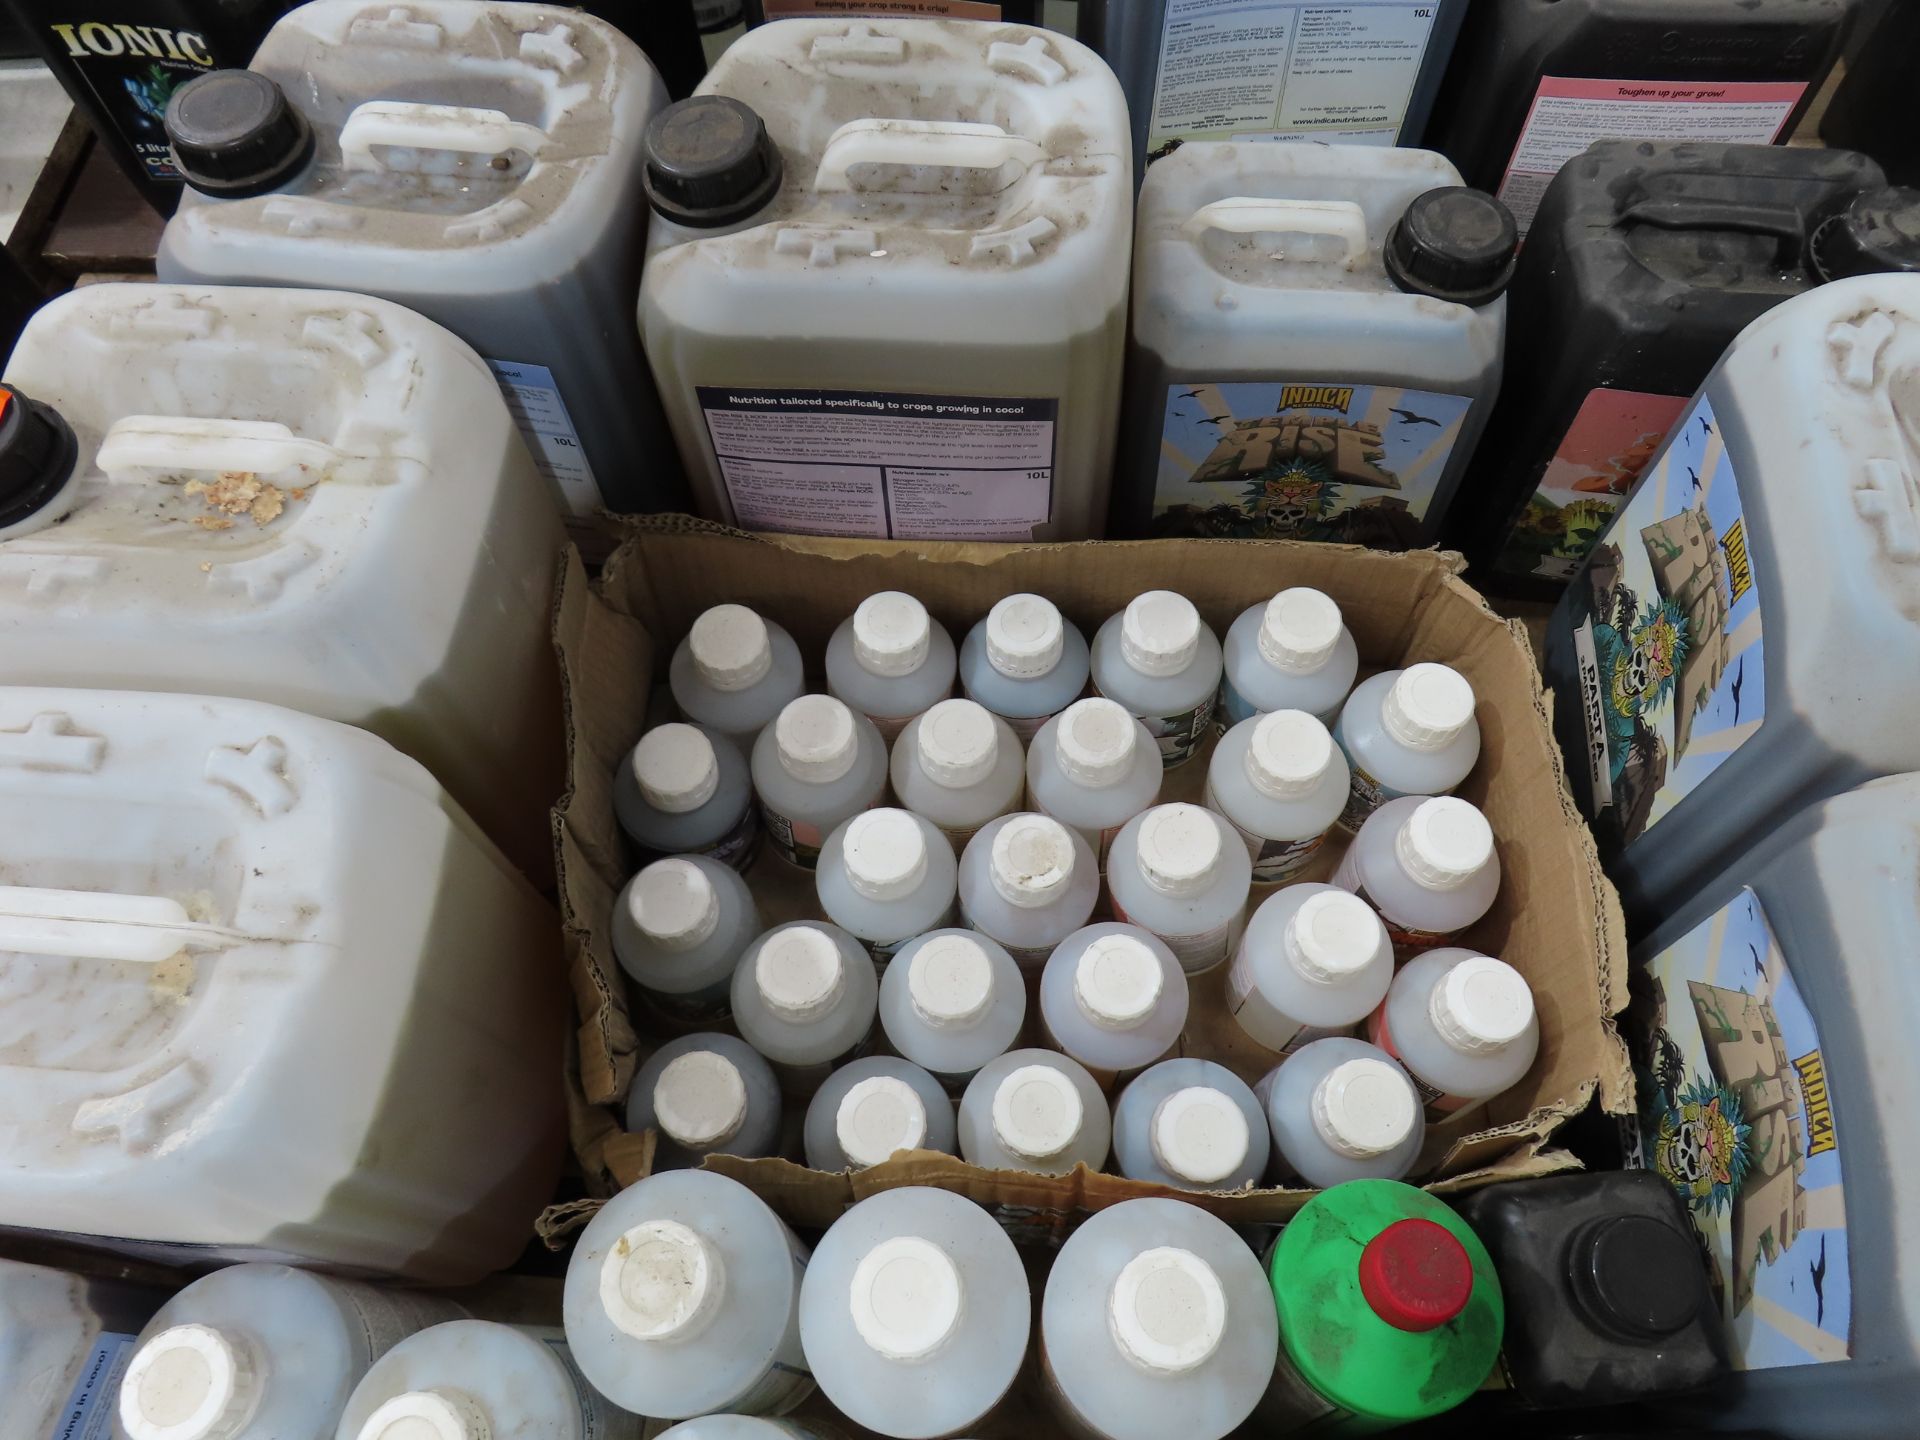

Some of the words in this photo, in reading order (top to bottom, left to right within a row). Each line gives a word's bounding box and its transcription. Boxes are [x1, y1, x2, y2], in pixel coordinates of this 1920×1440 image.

[815, 1, 846, 9] Keeping
[890, 2, 916, 10] strong
[1413, 9, 1431, 18] 10L
[51, 22, 213, 66] IONIC
[1618, 88, 1655, 97] Toughen
[1658, 90, 1669, 98] up
[1696, 90, 1725, 98] grow!
[1293, 116, 1387, 125] www.indicanutrients.com
[136, 144, 147, 152] 5
[729, 396, 777, 405] Nutrition
[781, 398, 821, 406] tailored
[825, 398, 885, 410] specifically
[903, 403, 933, 411] crops
[936, 405, 979, 414] growing
[982, 405, 992, 413] in
[995, 406, 1024, 414] coco!
[1278, 386, 1354, 414] INDICA
[1234, 415, 1380, 433] TEMPLE
[554, 437, 576, 447] 10L
[1189, 424, 1401, 490] RISE
[1719, 518, 1752, 608] INDICA
[1640, 508, 1722, 771] RISE
[1588, 664, 1602, 735] PART
[1596, 742, 1604, 760] A
[1791, 1048, 1836, 1159] INDICA
[1687, 980, 1796, 1319] RISE
[76, 1393, 88, 1405] in
[86, 1350, 108, 1389] coco!
